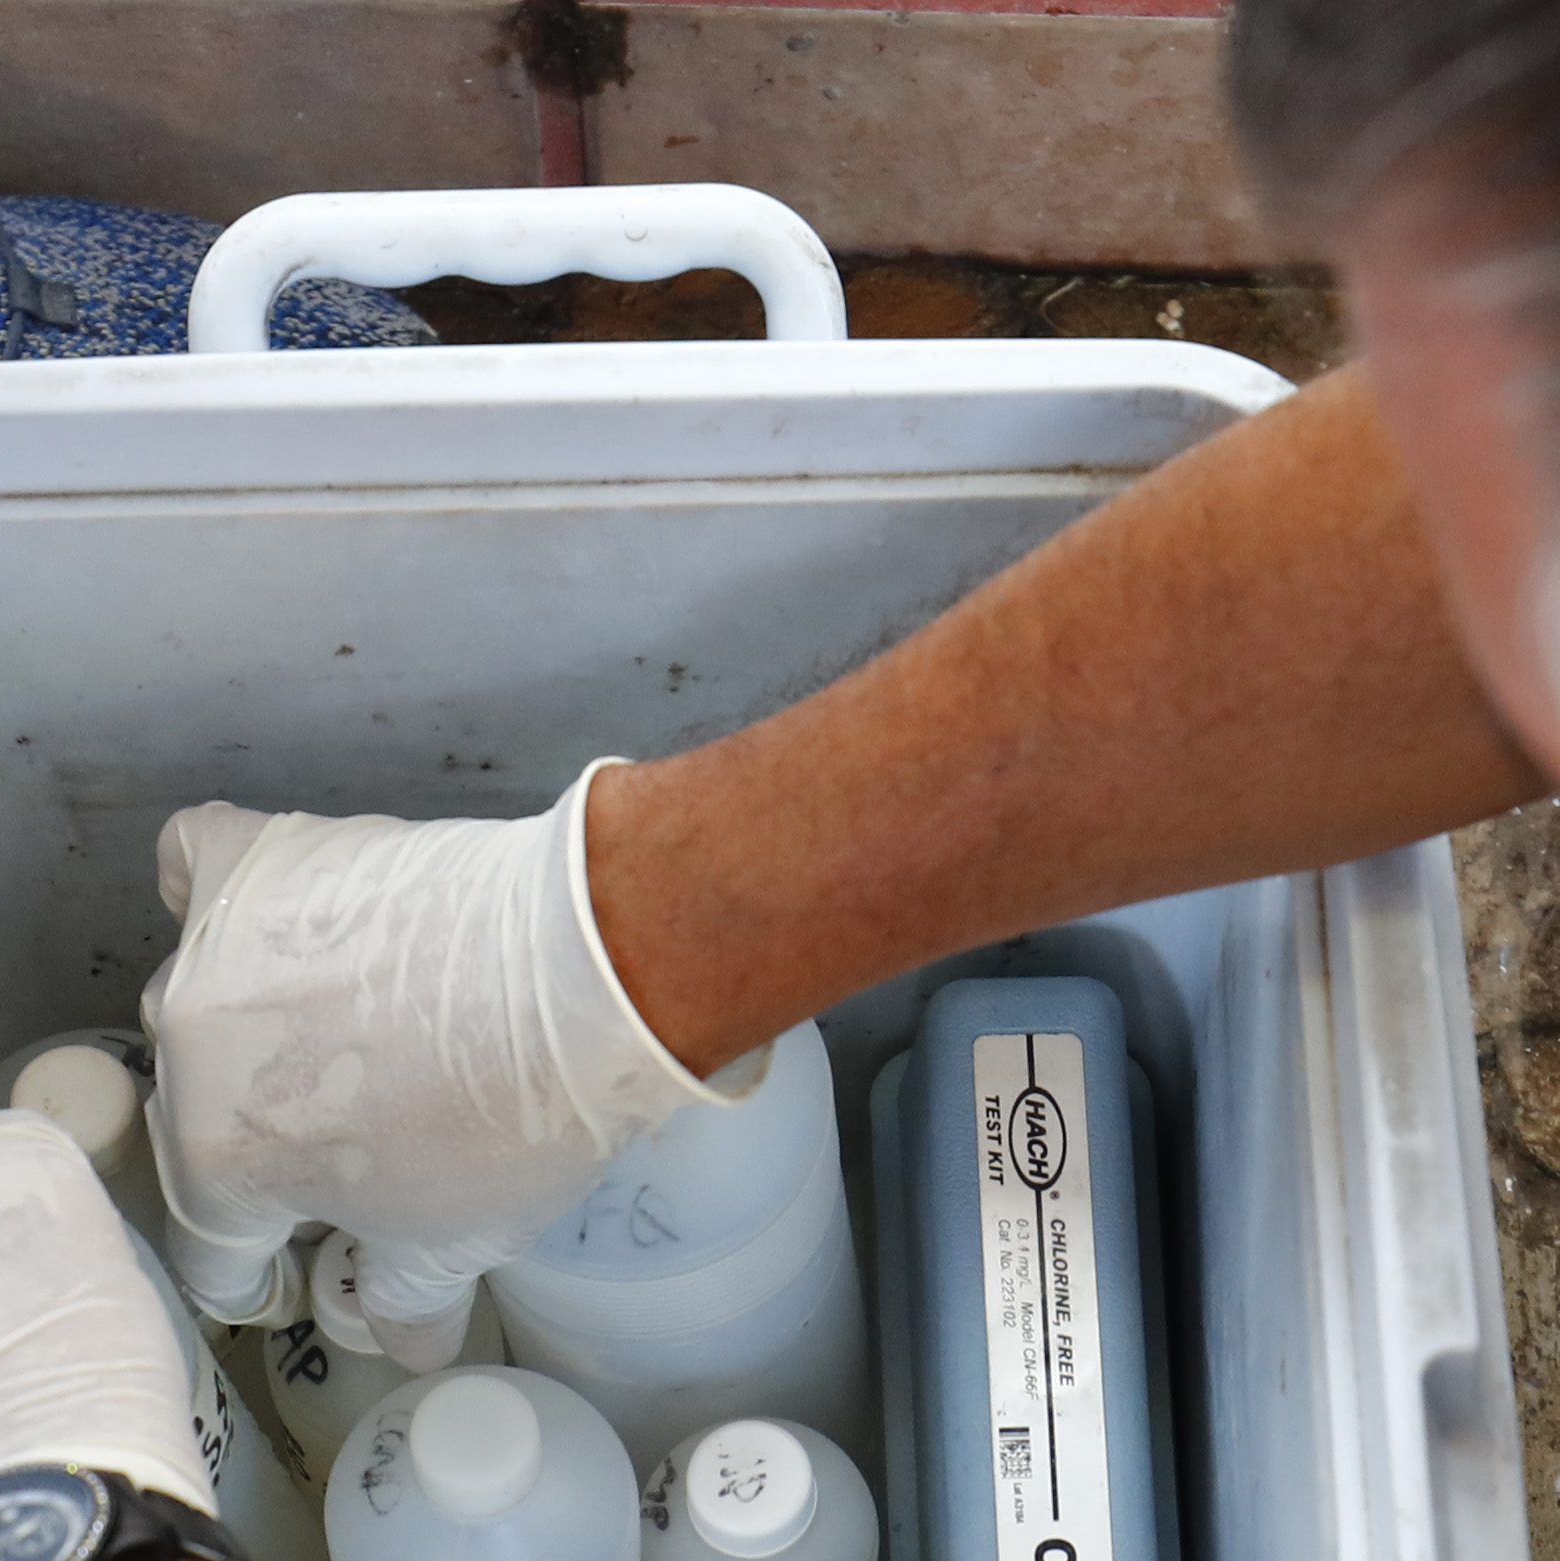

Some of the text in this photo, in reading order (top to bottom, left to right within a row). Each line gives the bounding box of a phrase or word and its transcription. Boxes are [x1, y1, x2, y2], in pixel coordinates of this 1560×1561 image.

[985, 1094, 1004, 1186] TEST KIT
[1000, 1276, 1016, 1329] 223102
[1020, 1300, 1036, 1344] Model
[1050, 1218, 1075, 1387] CHLORINE, FREE
[1021, 1347, 1038, 1402] CN-66F
